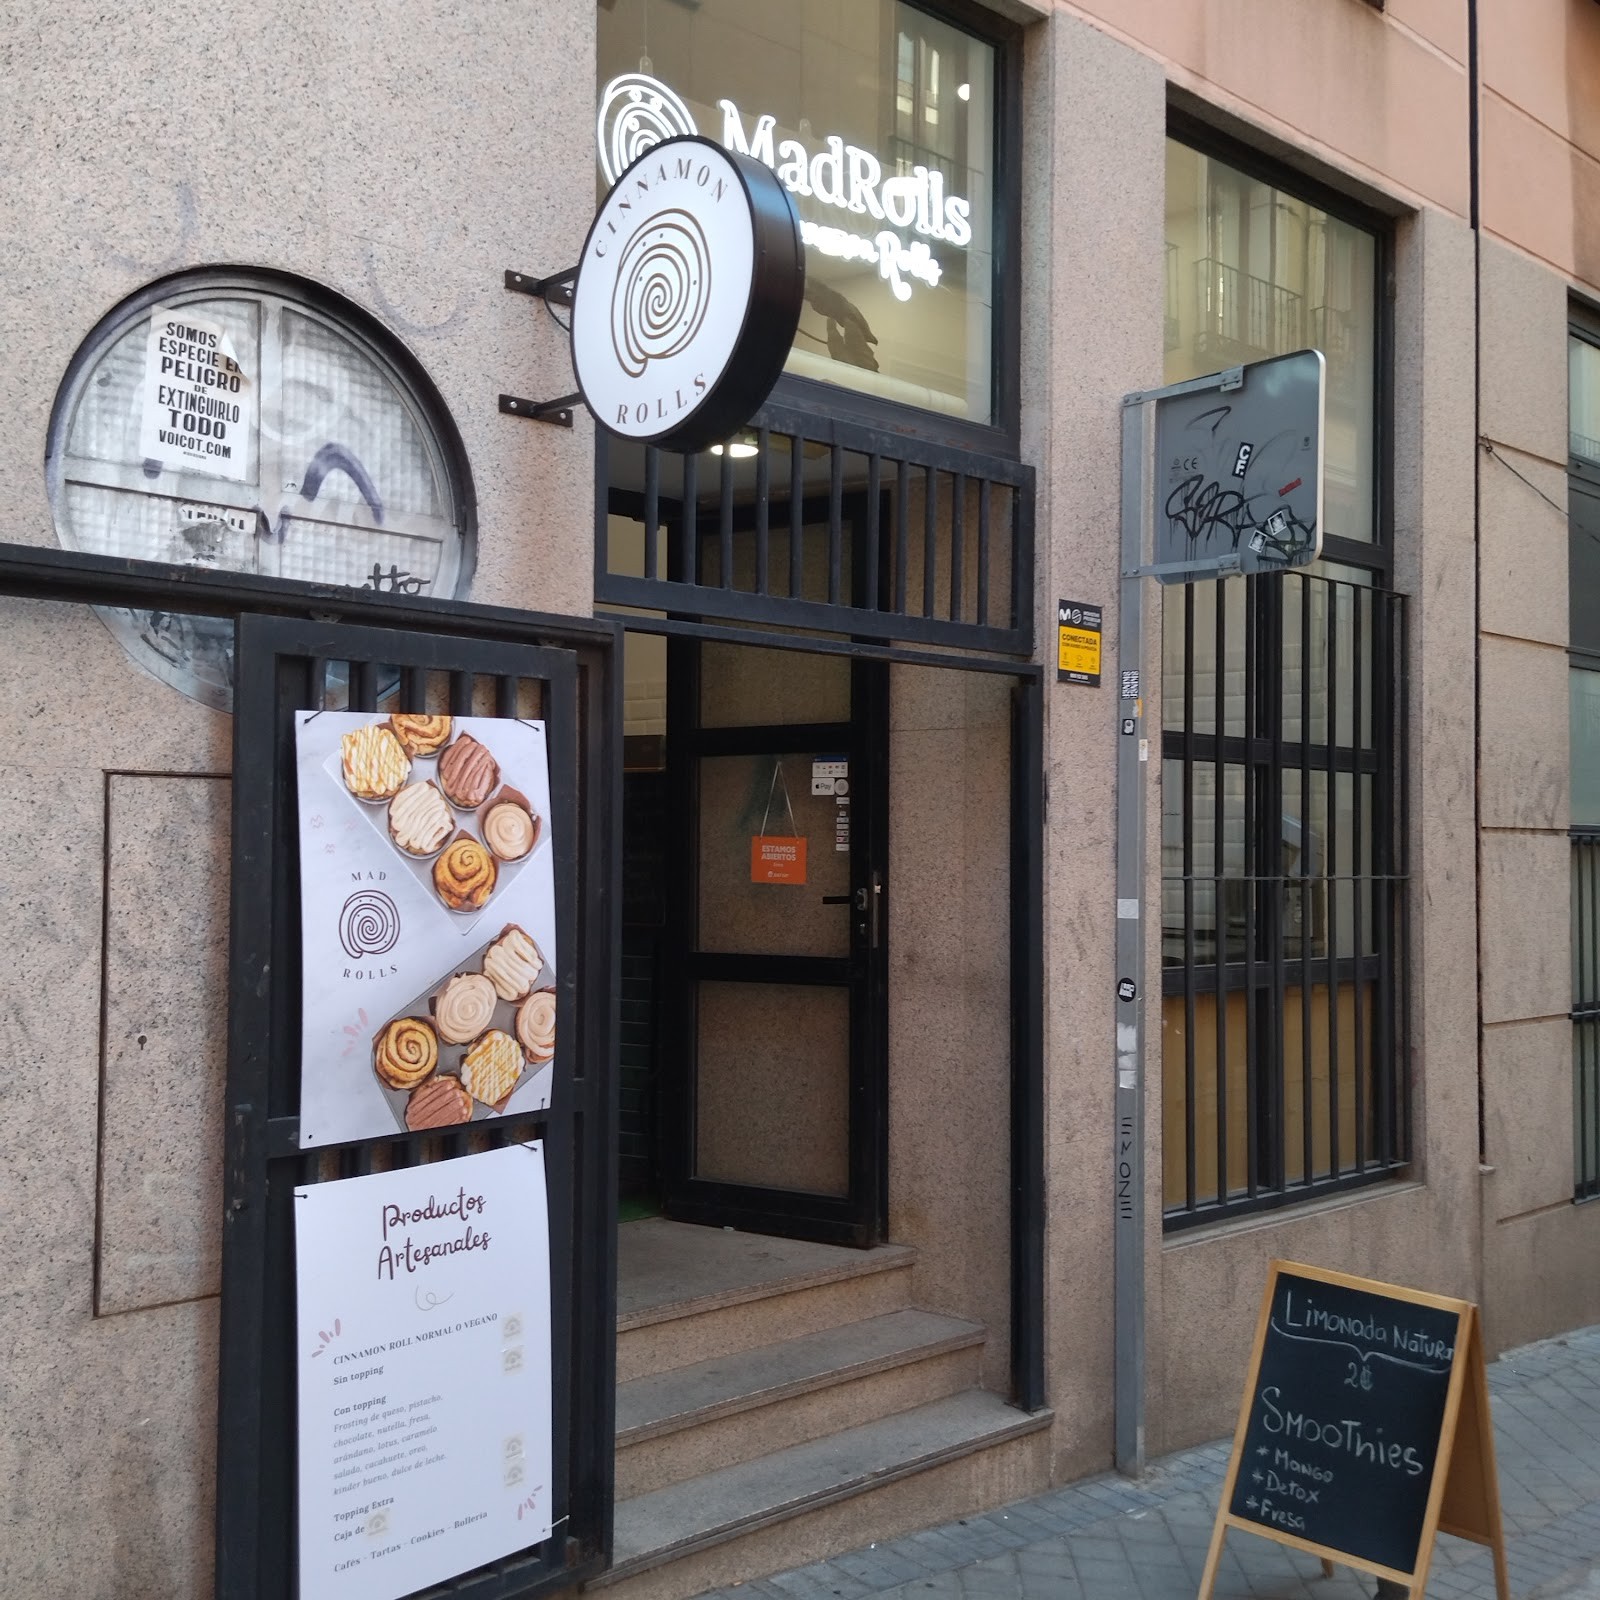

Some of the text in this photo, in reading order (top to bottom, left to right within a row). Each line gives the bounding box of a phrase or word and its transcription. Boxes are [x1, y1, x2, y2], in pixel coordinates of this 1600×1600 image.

[719, 99, 971, 245] MadRolls
[595, 157, 729, 259] CINNAMON
[166, 322, 217, 348] SOMOS
[159, 337, 219, 367] ESPECIE
[161, 356, 241, 393] PELIGRO
[194, 385, 208, 395] DE
[616, 372, 707, 425] ROLLS
[158, 385, 240, 424] EXTINGUIRLO
[168, 408, 226, 440] TODO
[159, 429, 232, 459] VOICOT.COM
[821, 783, 832, 791] Pay
[761, 853, 796, 861] ABIERTOS
[762, 845, 796, 853] ESTAMOS
[351, 871, 387, 882] MAD
[343, 965, 398, 980] ROLLS
[383, 1187, 486, 1241] Productos
[378, 1226, 492, 1280] Artesanales
[333, 1313, 498, 1365] CINNAMON ROLL NORMAL O VEGANO
[333, 1365, 384, 1386] Sin topping
[334, 1395, 387, 1417] Con topping
[334, 1416, 368, 1432] Frosting
[370, 1412, 380, 1422] de
[401, 1425, 438, 1443] caramelo
[334, 1480, 360, 1495] kinder
[391, 1463, 412, 1477] dulce
[414, 1460, 423, 1470] de
[334, 1497, 395, 1522] Topping Extra
[334, 1526, 365, 1542] Caja de
[334, 1558, 361, 1572] Cafés
[370, 1544, 401, 1560] Tartas
[410, 1528, 445, 1545] Cookies
